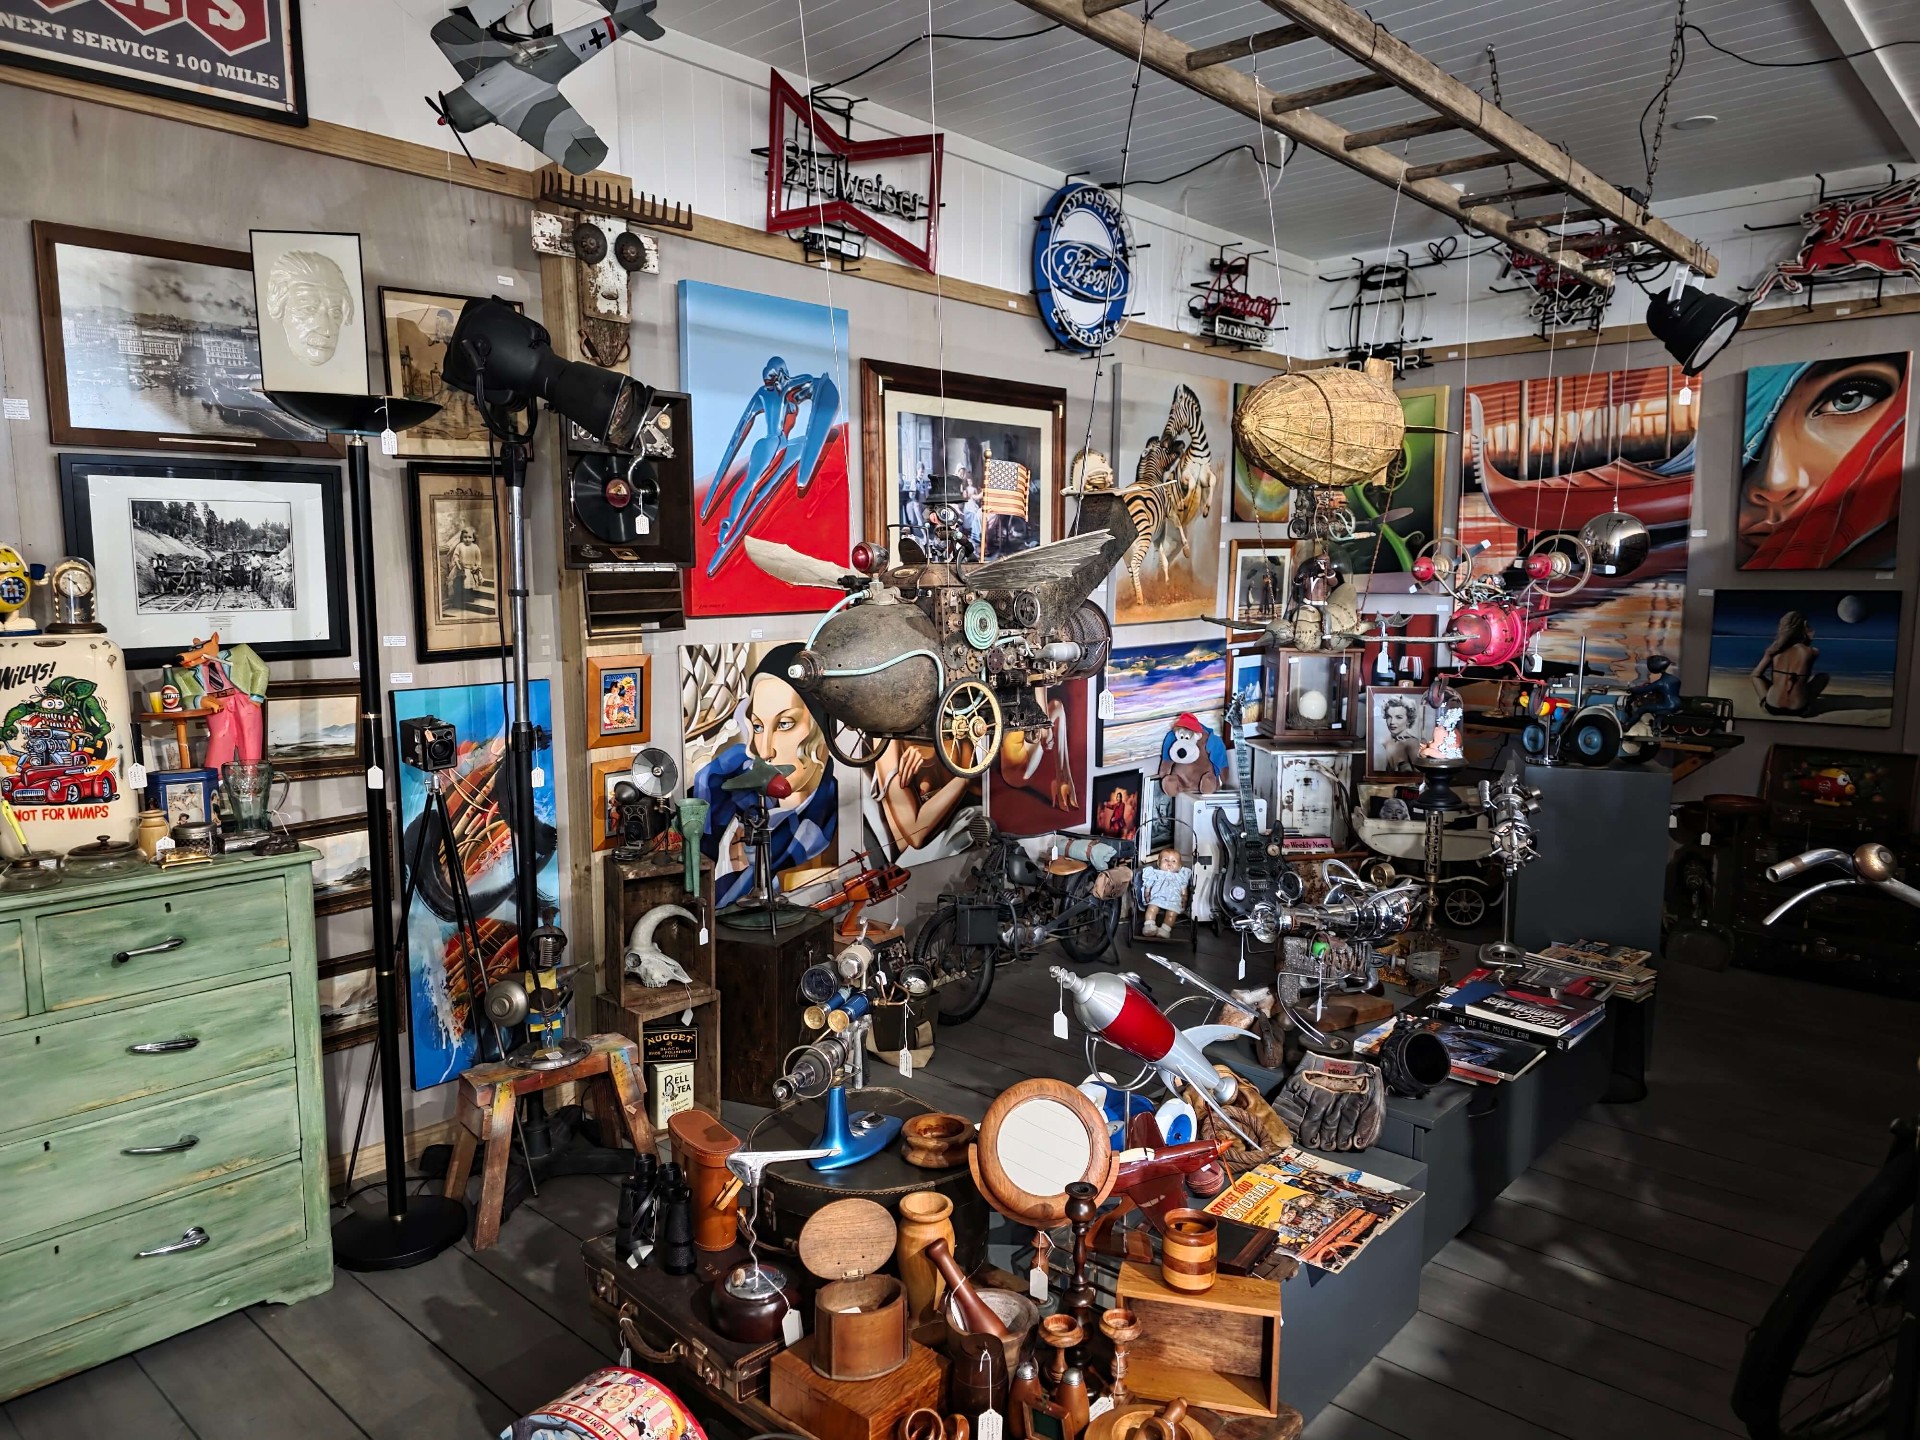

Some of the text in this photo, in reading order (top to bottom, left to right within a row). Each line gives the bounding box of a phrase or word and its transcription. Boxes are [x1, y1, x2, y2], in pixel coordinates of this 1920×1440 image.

[0, 13, 280, 90] NEXT SERVICE 100 MILES
[783, 138, 924, 221] Budweiser
[13, 808, 39, 823] NOT
[42, 807, 65, 821] FOR
[1290, 841, 1312, 850] Weekly
[1313, 841, 1329, 849] News
[1468, 1018, 1478, 1027] OF
[1479, 1020, 1490, 1031] THE
[663, 1074, 690, 1099] BELL
[676, 1083, 692, 1095] TEA
[1209, 1191, 1242, 1217] STREET
[574, 1410, 612, 1438] HUMPTY
